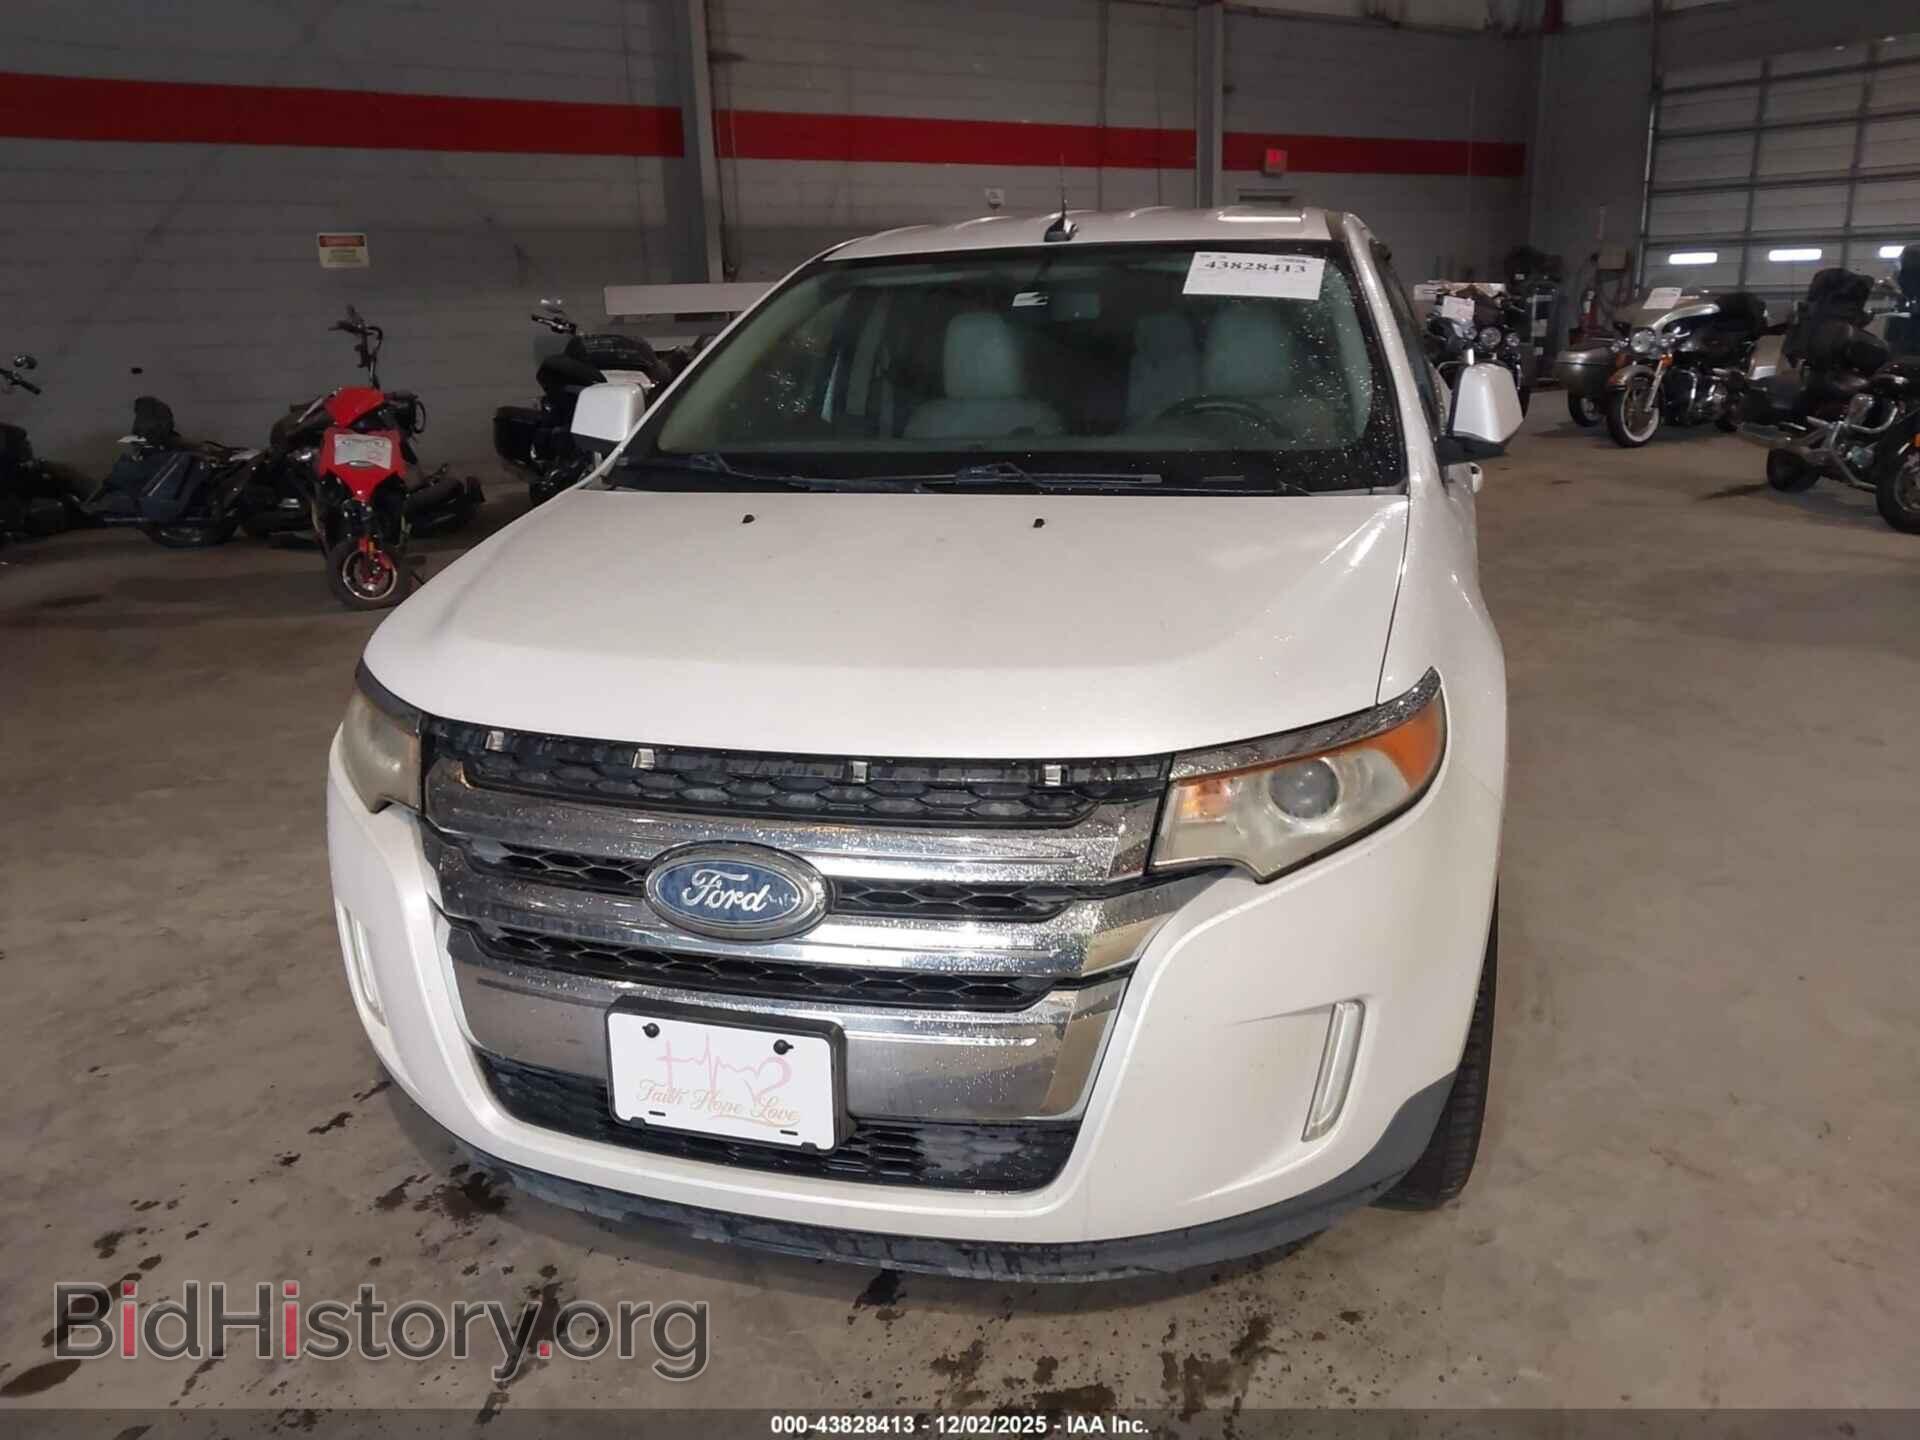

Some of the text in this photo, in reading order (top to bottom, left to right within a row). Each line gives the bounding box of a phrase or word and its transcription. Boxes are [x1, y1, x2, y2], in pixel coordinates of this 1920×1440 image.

[1204, 260, 1306, 273] 43828413
[681, 868, 771, 912] Ford
[637, 1079, 801, 1123] Faith Hope Love
